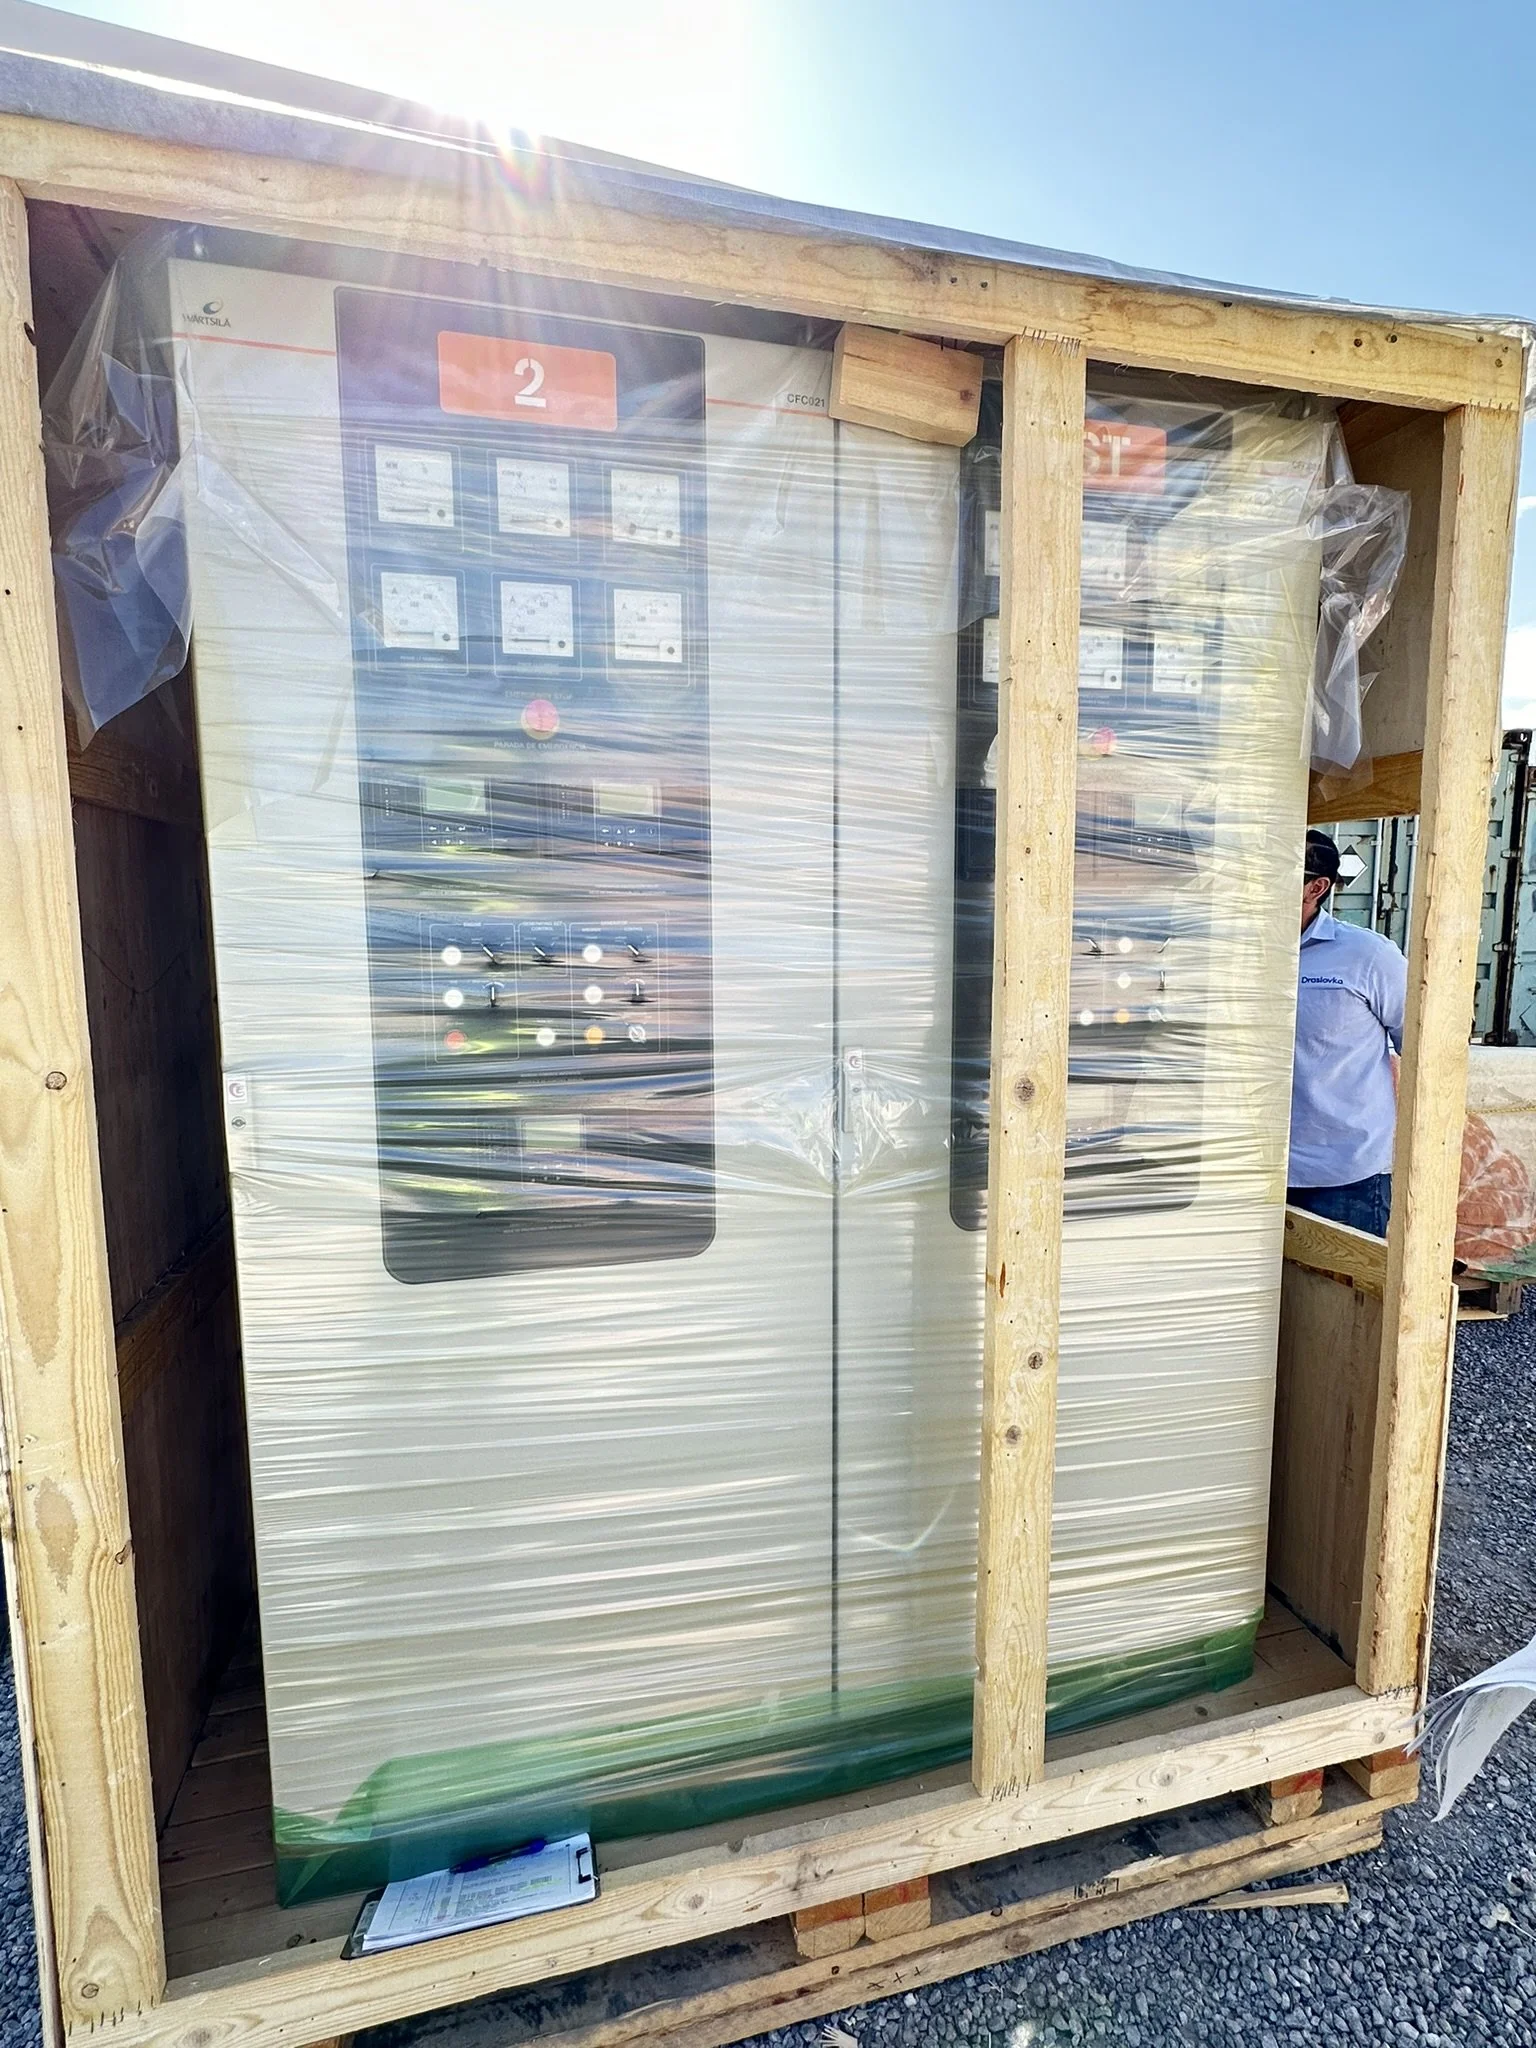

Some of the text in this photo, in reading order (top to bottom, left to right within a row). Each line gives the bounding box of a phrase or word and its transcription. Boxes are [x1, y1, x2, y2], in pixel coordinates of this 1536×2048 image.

[513, 357, 547, 409] 2
[786, 393, 826, 408] CFC021
[1300, 975, 1344, 985] Draslovka
